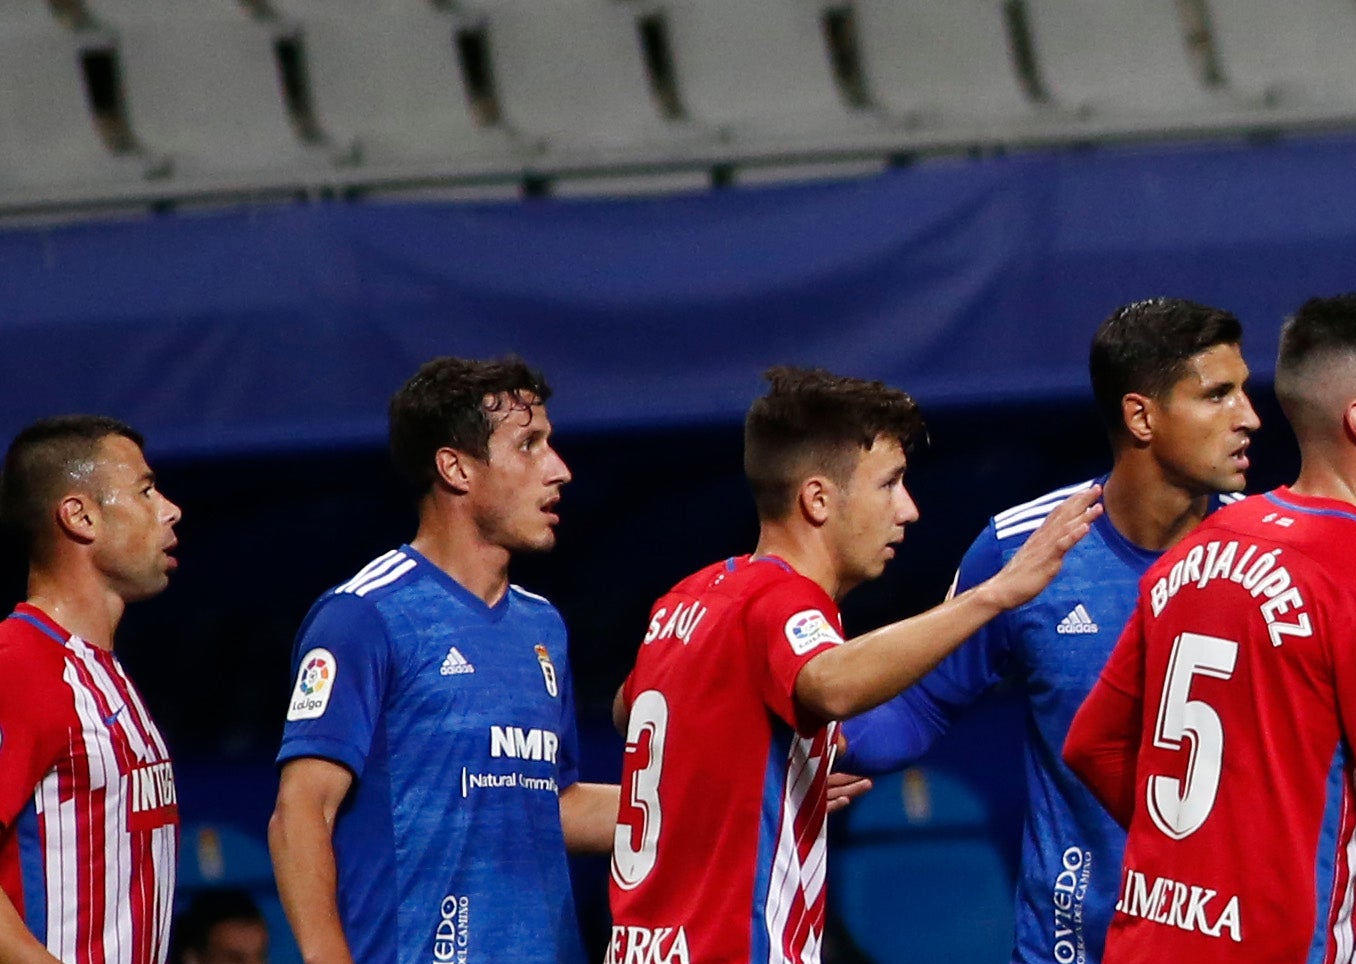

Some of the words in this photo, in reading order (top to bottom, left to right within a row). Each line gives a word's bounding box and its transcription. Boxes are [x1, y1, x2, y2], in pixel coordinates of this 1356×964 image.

[1057, 622, 1098, 633] adidas
[440, 664, 475, 676] adidas
[292, 699, 323, 712] LaLiga
[490, 725, 559, 765] NMR
[1146, 631, 1239, 841] 5
[469, 772, 517, 788] Natural
[611, 690, 669, 890] 3
[457, 896, 470, 947] CAMINO
[1054, 846, 1083, 964] OVIEDO
